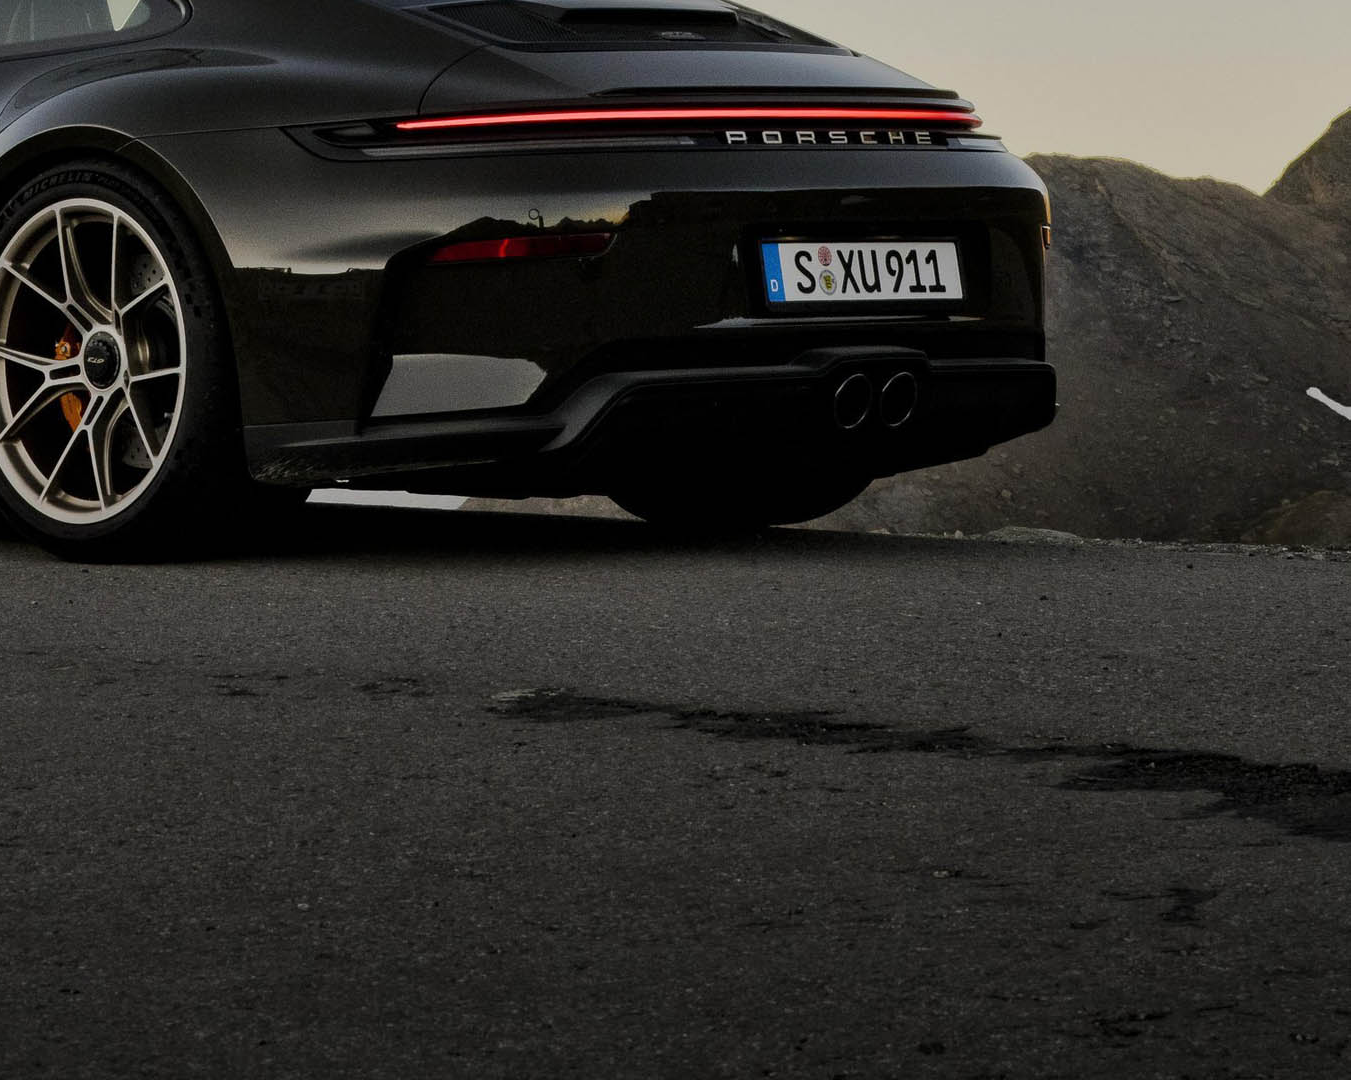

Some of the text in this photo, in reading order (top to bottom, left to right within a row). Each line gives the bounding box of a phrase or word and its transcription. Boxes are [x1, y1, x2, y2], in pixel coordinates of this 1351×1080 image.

[725, 130, 932, 145] PORSCHE
[794, 250, 816, 294] S
[770, 279, 779, 292] D
